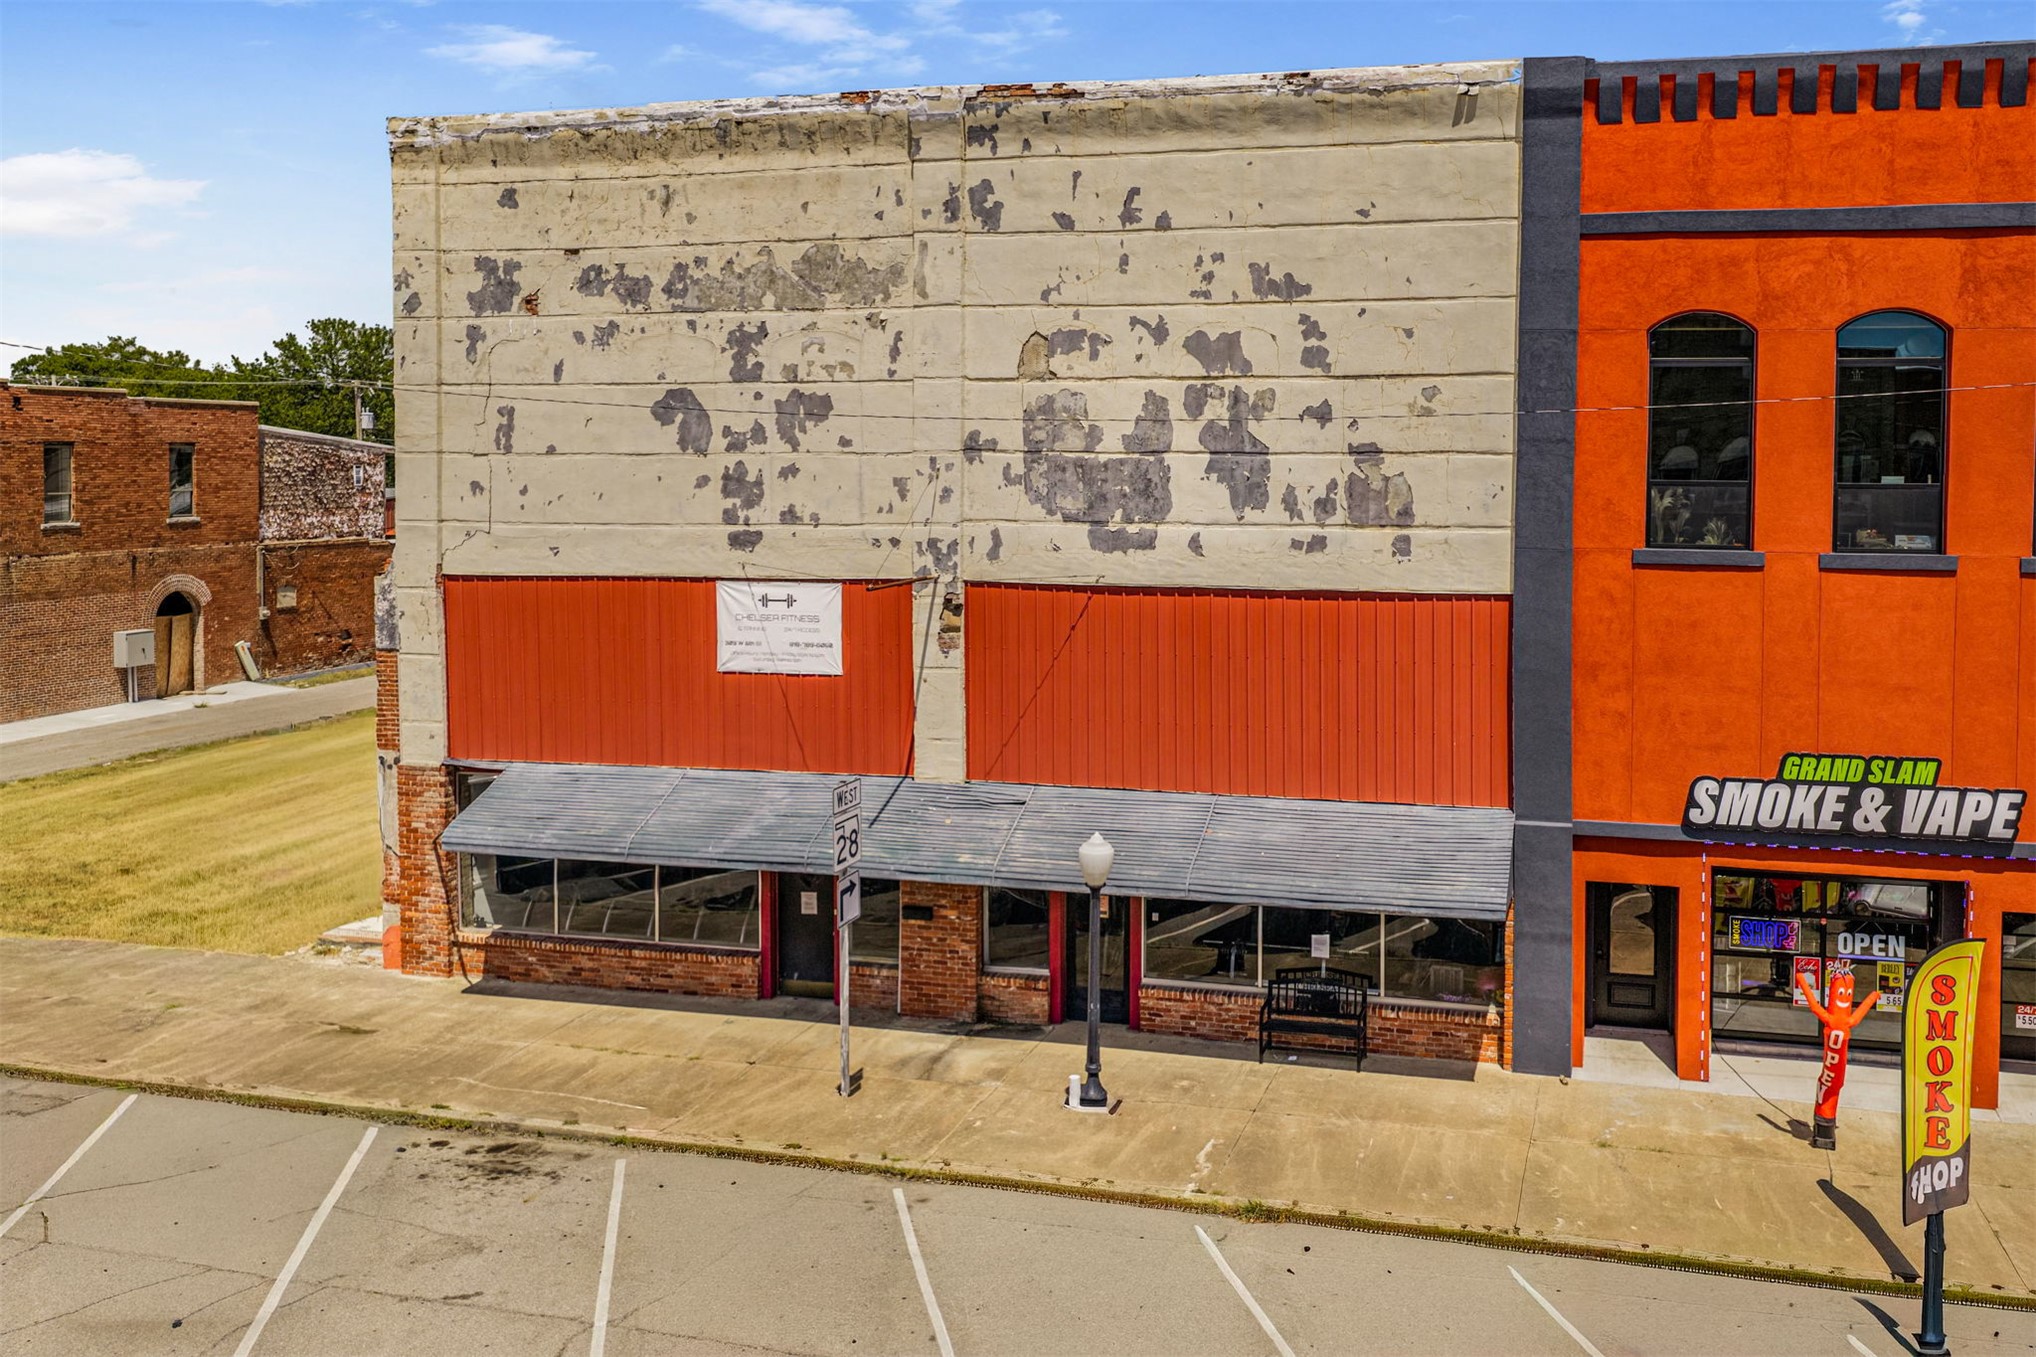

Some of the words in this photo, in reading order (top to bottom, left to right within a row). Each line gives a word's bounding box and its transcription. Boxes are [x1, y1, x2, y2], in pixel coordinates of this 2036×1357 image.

[735, 613, 780, 622] CHELSEA
[781, 614, 820, 623] FITNESS
[1783, 756, 1865, 783] GRAND
[1868, 758, 1938, 785] SLAM
[836, 786, 858, 808] WEST
[1688, 778, 1850, 831] SMOKE
[1852, 787, 1893, 833] &
[1900, 789, 2024, 839] VAPE
[836, 828, 859, 866] 28
[1732, 920, 1740, 944] SMOKE
[1740, 920, 1788, 948] SHOP
[1838, 932, 1905, 958] OPEN
[1817, 1030, 1844, 1104] OPEN
[1924, 974, 1958, 1150] SMOKE
[1911, 1156, 1964, 1205] SHOP
